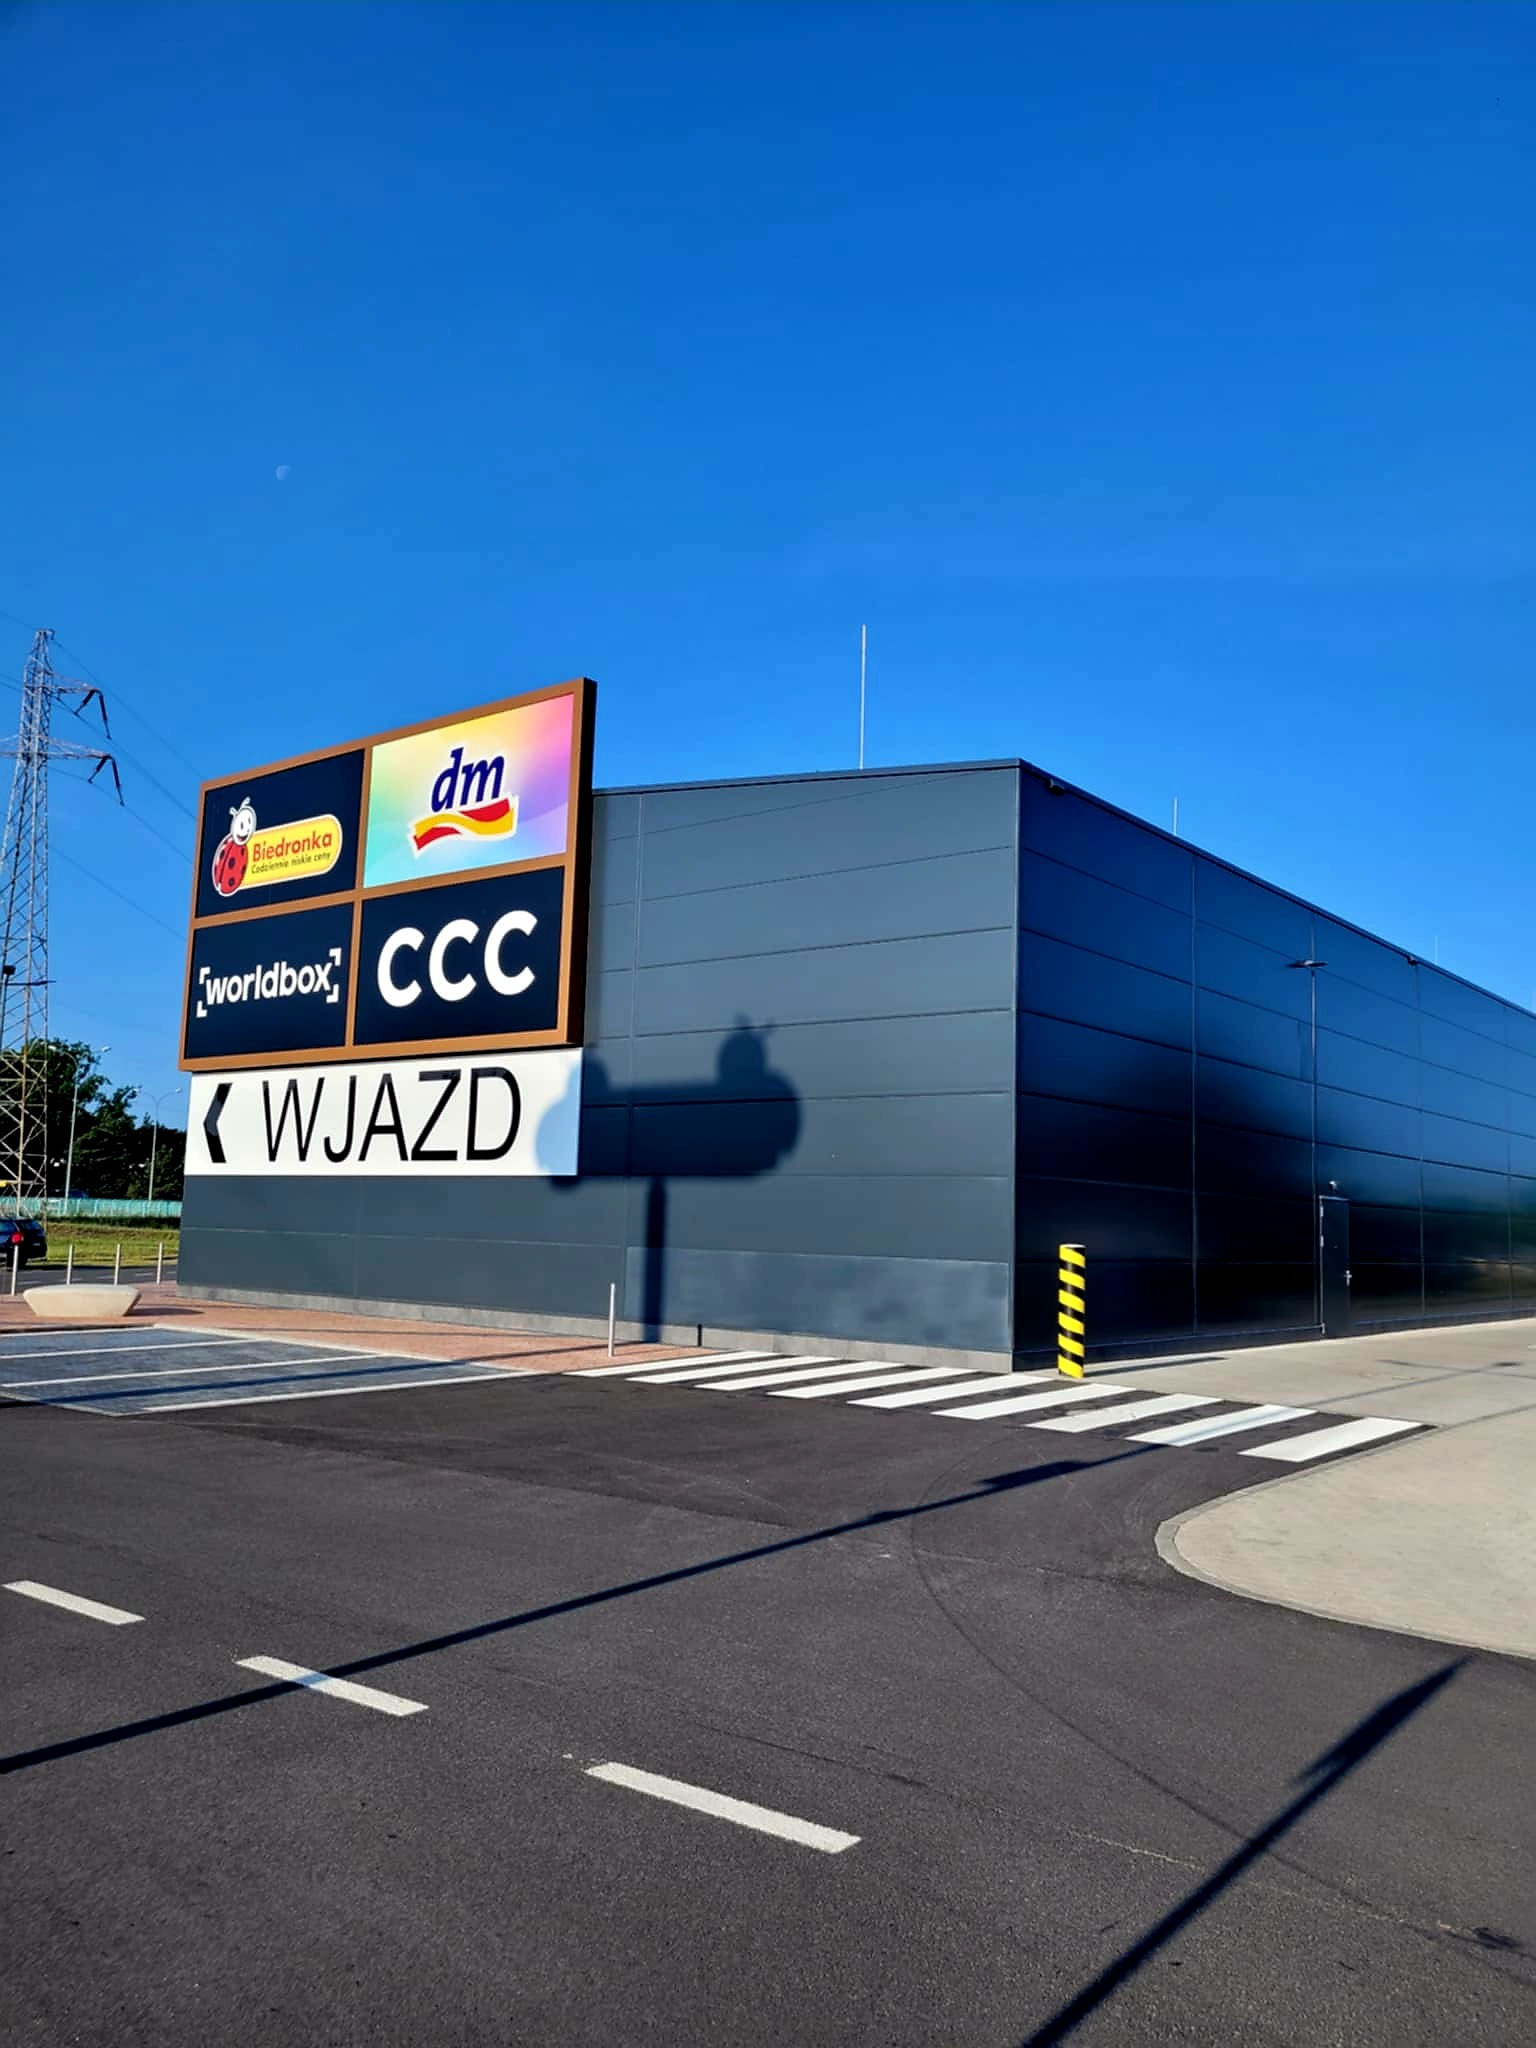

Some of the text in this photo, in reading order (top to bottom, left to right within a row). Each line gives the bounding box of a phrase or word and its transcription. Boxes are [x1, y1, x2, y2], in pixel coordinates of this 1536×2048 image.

[430, 747, 505, 813] dm
[253, 831, 332, 862] Biedronka
[377, 910, 538, 1008] CCC
[262, 1066, 522, 1163] WJAZD
